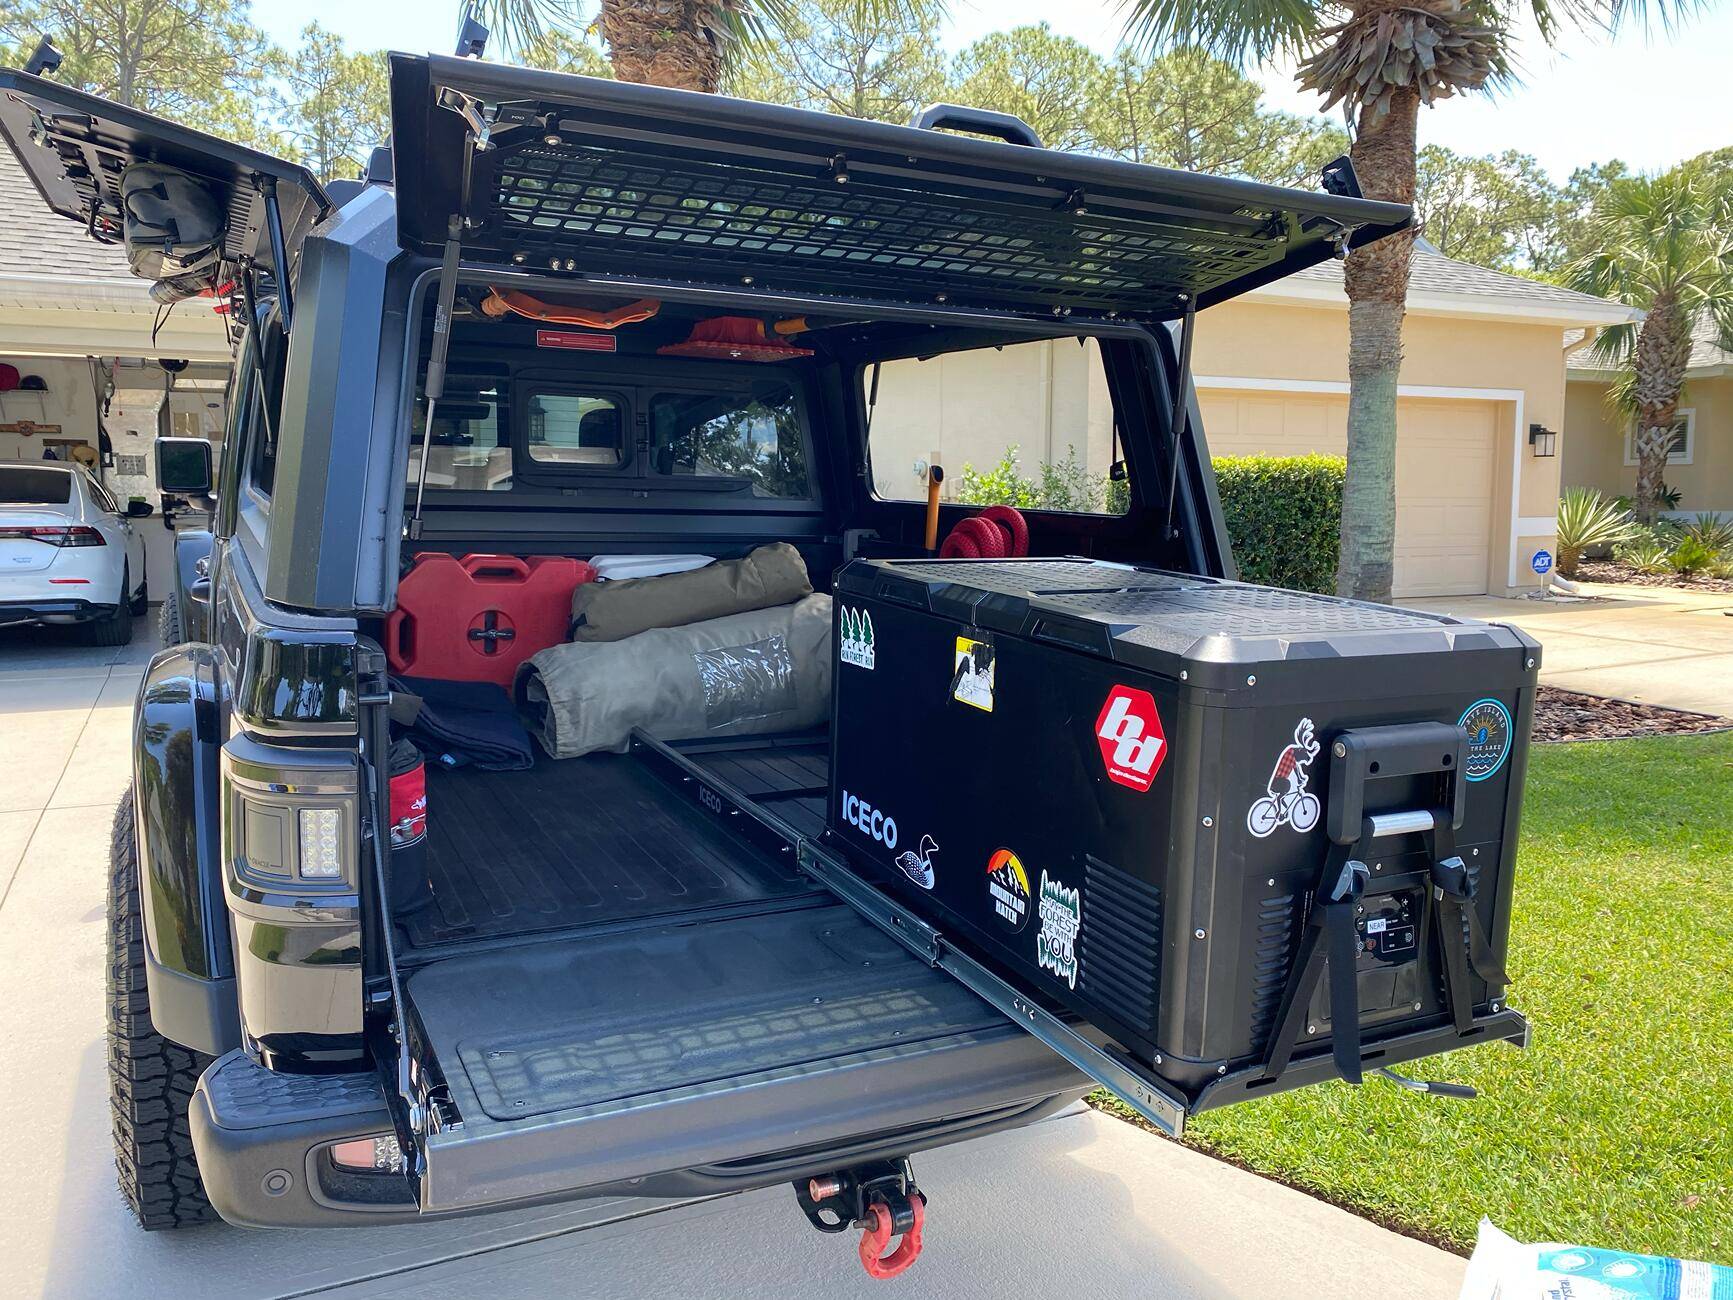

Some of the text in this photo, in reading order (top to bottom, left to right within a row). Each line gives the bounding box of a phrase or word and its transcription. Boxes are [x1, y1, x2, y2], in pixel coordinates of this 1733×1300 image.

[1534, 556, 1551, 567] ADT
[1484, 706, 1506, 728] ISLAND
[700, 785, 721, 814] ICECO
[842, 789, 898, 849] ICECO
[1040, 904, 1078, 936] FOREST
[1044, 920, 1072, 944] BE WITH
[1370, 921, 1385, 930] NEAR
[1043, 929, 1072, 964] YOU
